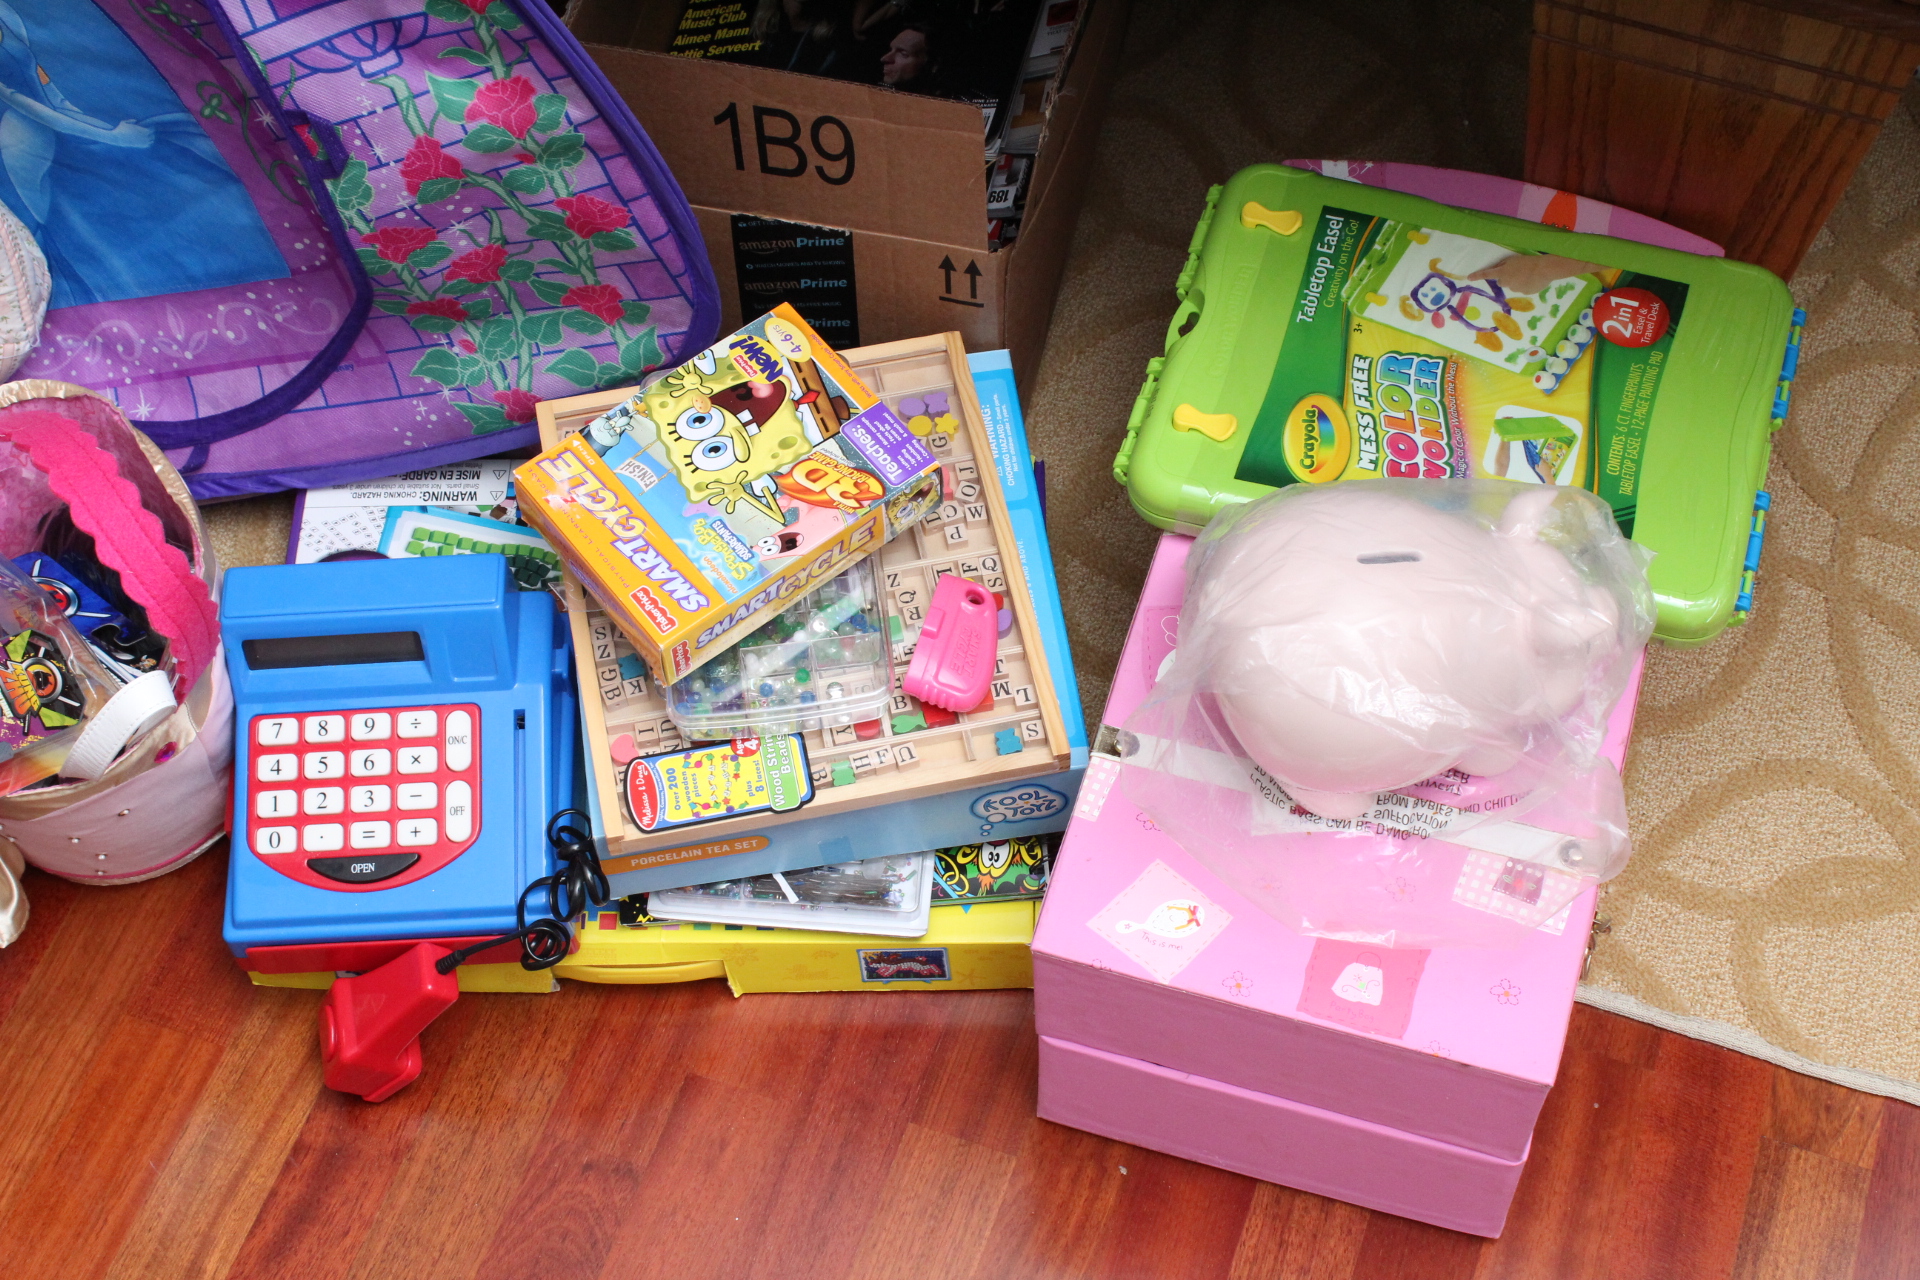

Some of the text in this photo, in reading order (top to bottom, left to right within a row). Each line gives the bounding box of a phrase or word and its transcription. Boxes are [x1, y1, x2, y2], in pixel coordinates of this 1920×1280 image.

[679, 10, 747, 30] Music Club
[683, 3, 742, 20] American
[673, 26, 750, 46] Aimee Mann
[707, 40, 763, 56] Serveert
[714, 102, 855, 185] 1B9
[1297, 214, 1345, 323] Tabletop Easel
[1323, 219, 1360, 308] Creativity on the Go!
[1353, 322, 1363, 334] 3+
[1633, 307, 1649, 335] Easel &
[1641, 302, 1660, 344] Travel Desk
[1447, 362, 1458, 383] Mess!
[1448, 383, 1456, 395] the
[1620, 363, 1644, 414] FINGERPAINTS
[1351, 354, 1380, 471] MESS FREE
[1448, 395, 1461, 426] Without
[1616, 413, 1630, 427] CT.
[1619, 350, 1664, 496] TABLETOP EASEL 12-PAGE PAINTING PAD
[932, 436, 948, 448] G
[1299, 408, 1319, 470] Crayola
[1455, 426, 1465, 447] Color
[851, 424, 903, 481] Teaches:
[999, 424, 1015, 486] CHOKING HAZARD
[1457, 446, 1465, 456] of
[1606, 433, 1626, 476] CONTENTS:
[439, 470, 454, 480] EN
[455, 470, 481, 480] MISE
[792, 460, 884, 508] 3D
[350, 491, 478, 502] WARNING: CHOKING HAZARD.
[712, 520, 752, 562] SQUAREPANTS
[595, 547, 631, 589] PHYSICAL
[703, 556, 738, 594] nickelodeon
[961, 563, 978, 574] F
[982, 557, 998, 572] Q
[987, 577, 1003, 588] S
[899, 590, 916, 604] Q
[635, 589, 671, 631] Fisher-Price
[907, 606, 923, 621] R
[604, 686, 622, 700] B
[628, 680, 644, 695] K
[892, 695, 908, 710] B
[272, 717, 468, 746] 7 8 9 ON/C
[1026, 723, 1039, 738] S
[270, 754, 375, 776] 4 5 6
[852, 754, 872, 770] H
[876, 748, 889, 764] F
[681, 771, 692, 802] wooden
[690, 772, 702, 798] pieces
[753, 759, 765, 793] 8 laces!
[665, 767, 682, 811] Over 200
[746, 780, 756, 797] plus
[771, 769, 785, 807] Wood
[271, 790, 466, 816] 1 2 3 OFF
[983, 790, 1048, 812] KOOL
[1004, 799, 1058, 817] TOYZ
[269, 831, 281, 849] 0
[631, 839, 759, 867] PORCELAIN TEA SET
[351, 862, 375, 873] OPEN
[1141, 931, 1157, 947] This
[1157, 940, 1166, 949] is
